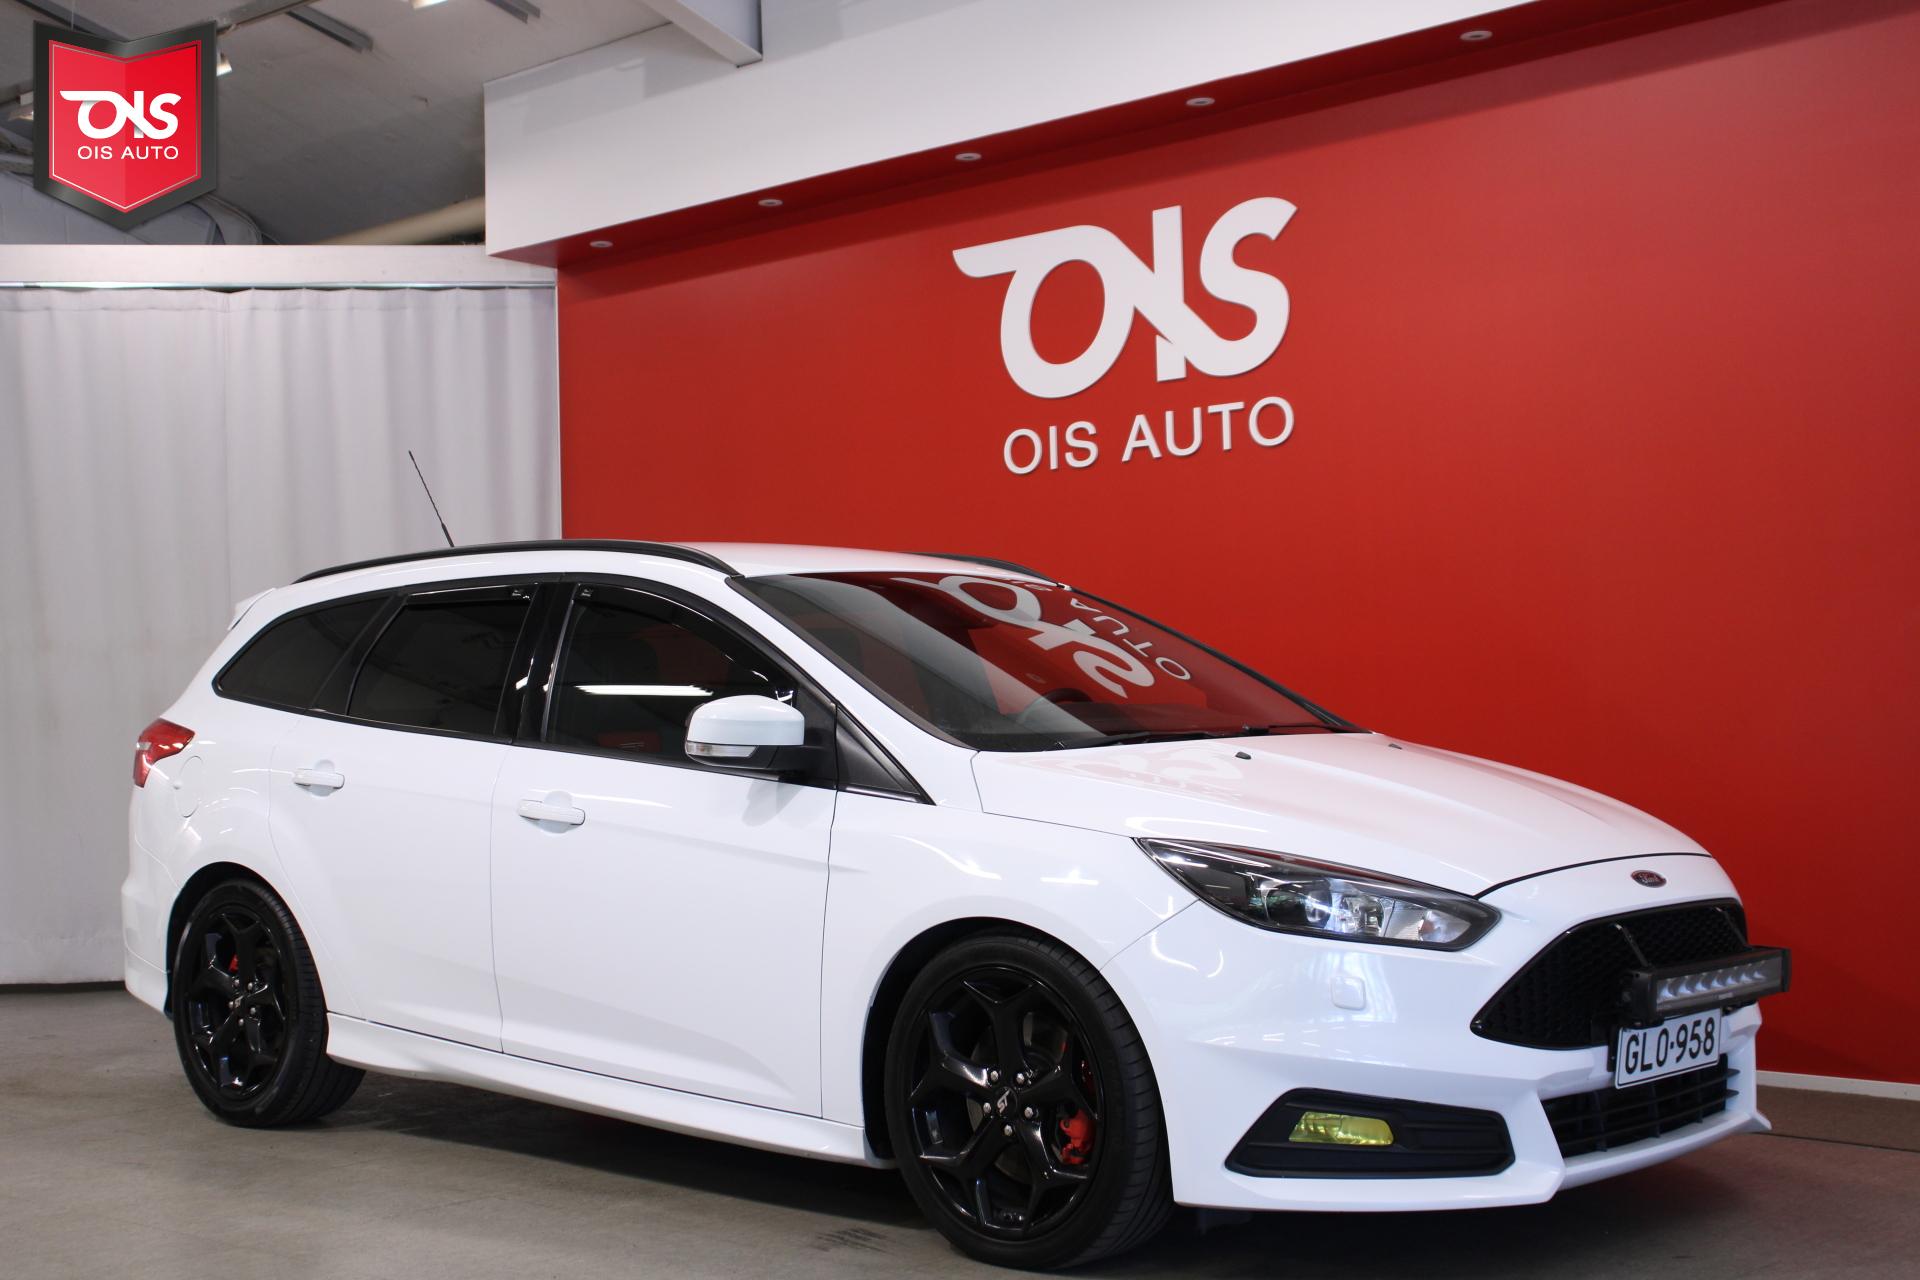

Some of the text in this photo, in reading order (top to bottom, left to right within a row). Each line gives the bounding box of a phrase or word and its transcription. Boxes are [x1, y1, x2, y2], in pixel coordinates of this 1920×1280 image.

[952, 197, 1298, 399] OIS
[1003, 396, 1295, 475] OIS AUTO
[1625, 1017, 1715, 1075] GLO-958
[997, 1090, 1010, 1113] ST
